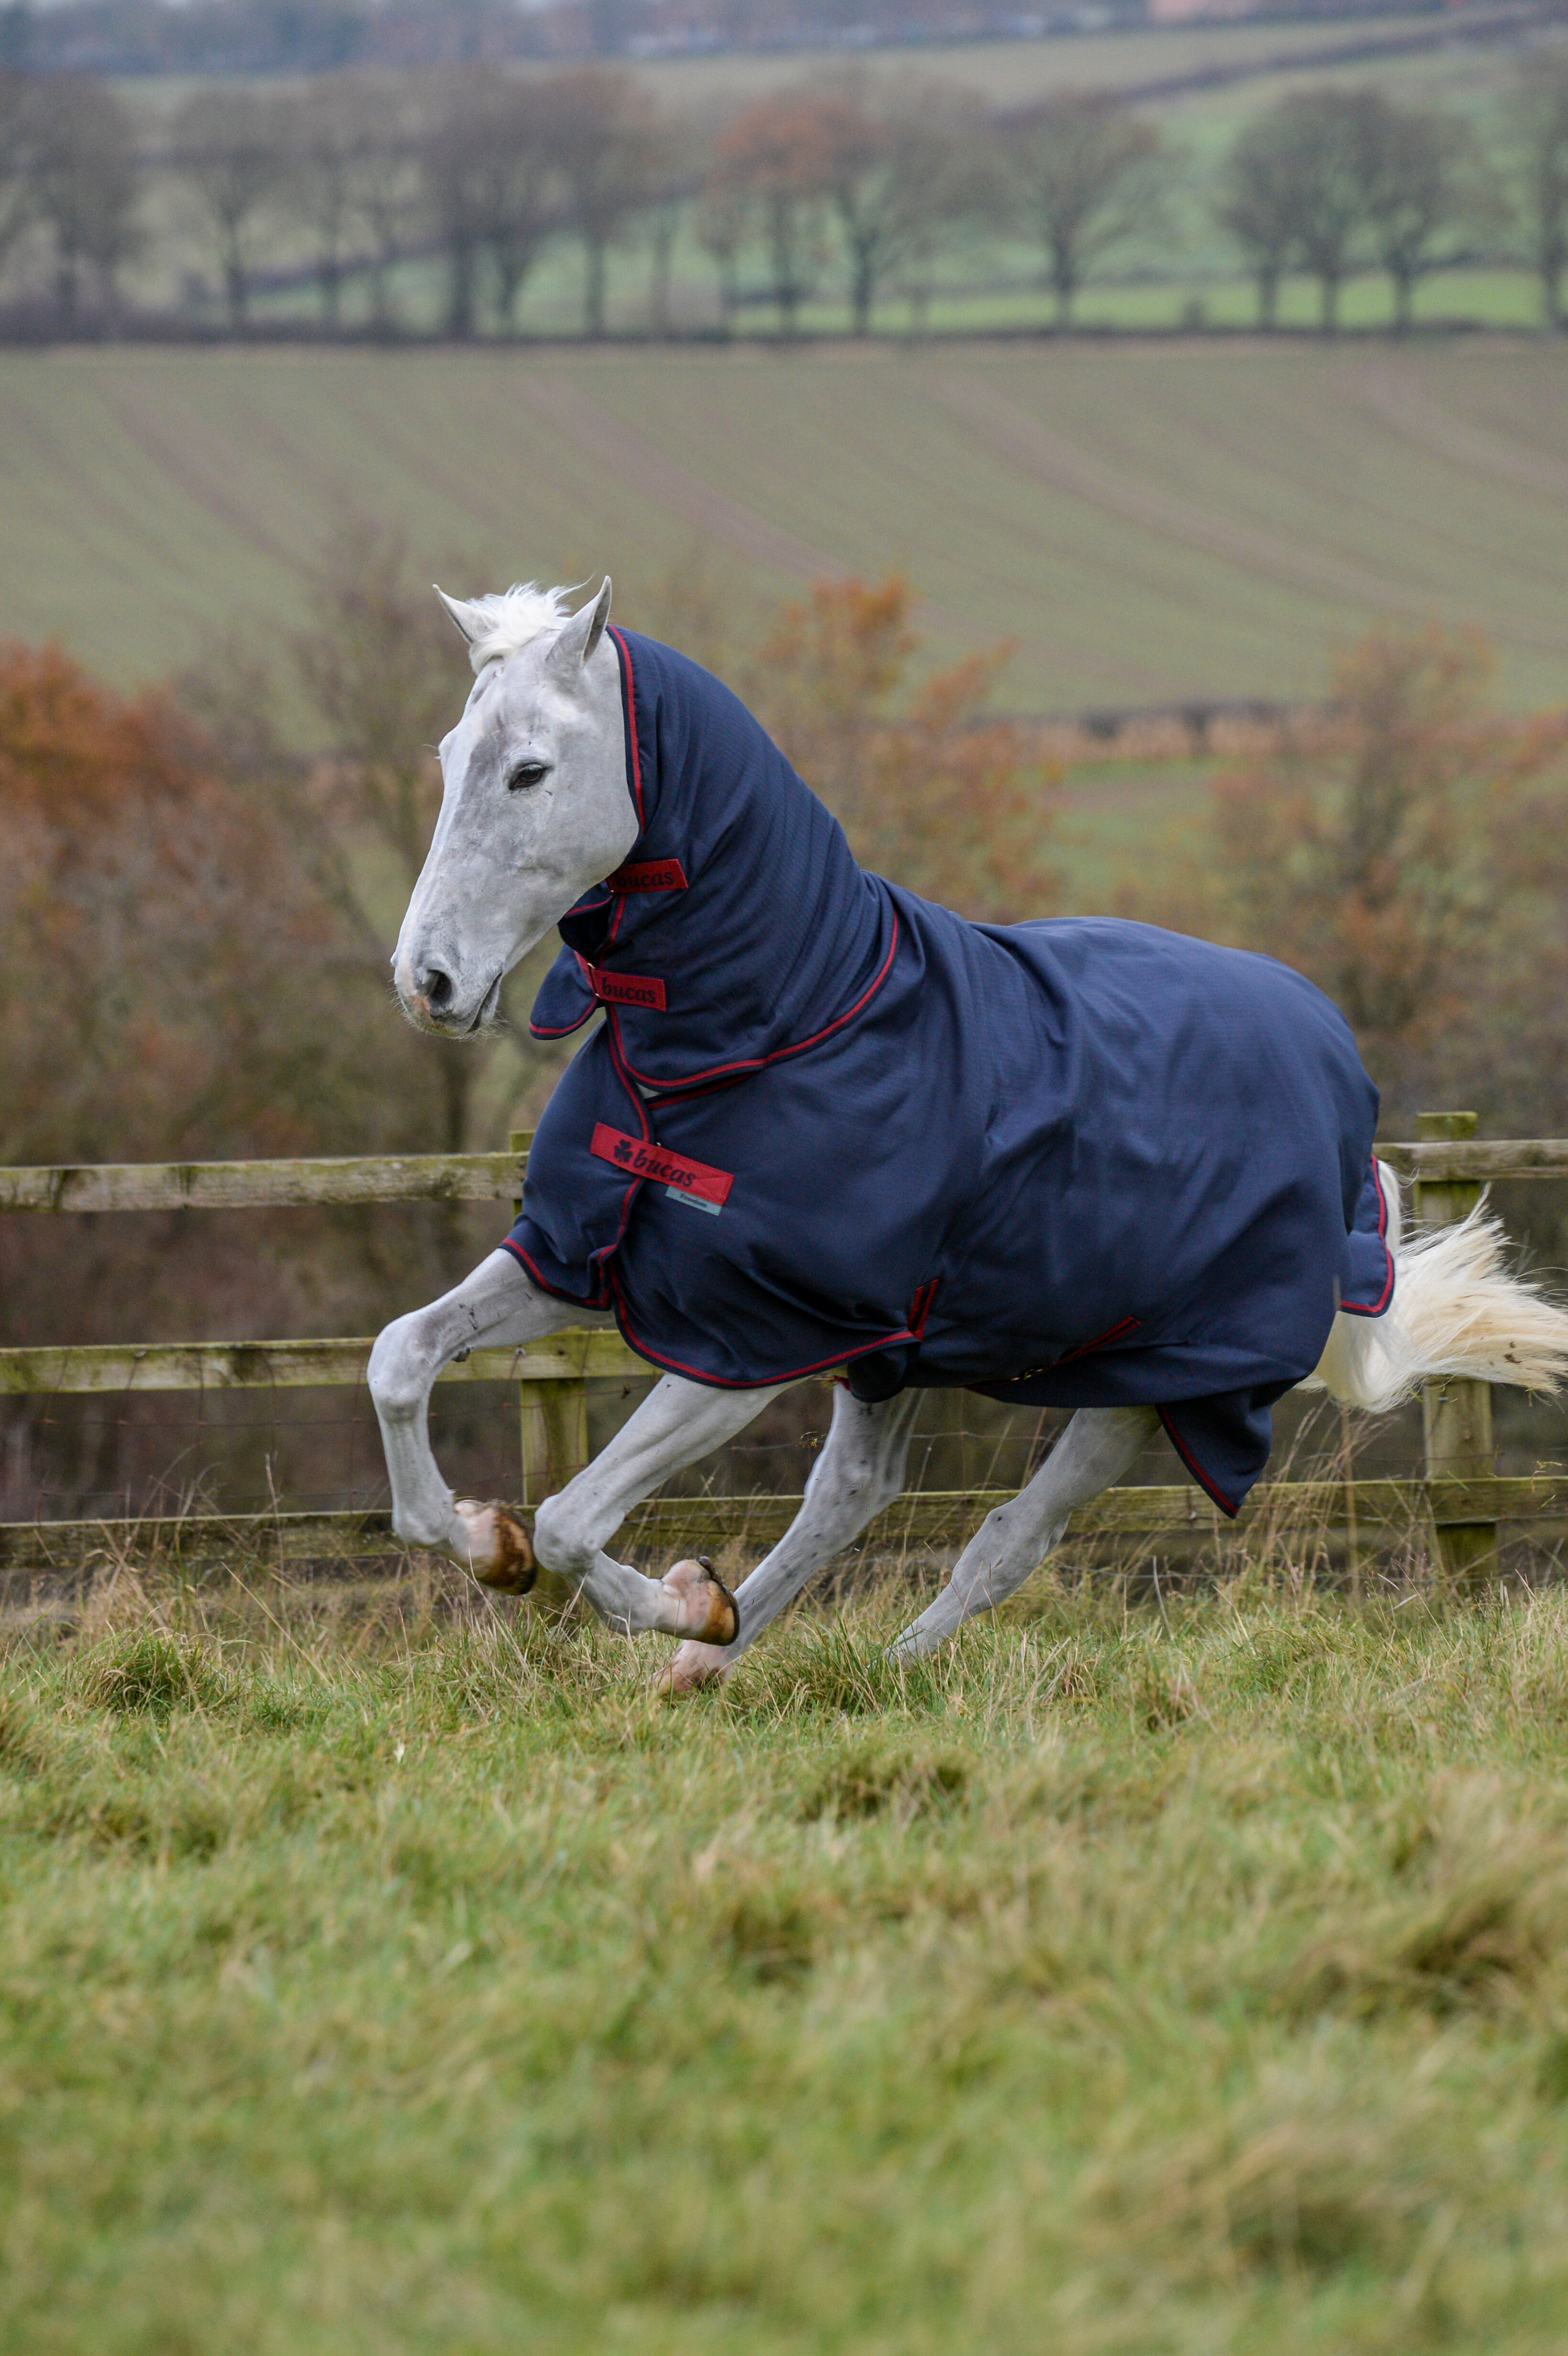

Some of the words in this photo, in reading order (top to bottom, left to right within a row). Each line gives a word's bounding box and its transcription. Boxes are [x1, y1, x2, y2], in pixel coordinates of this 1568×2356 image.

[616, 871, 674, 887] bucas
[601, 978, 656, 1003] bucas
[633, 1149, 697, 1187] bucas
